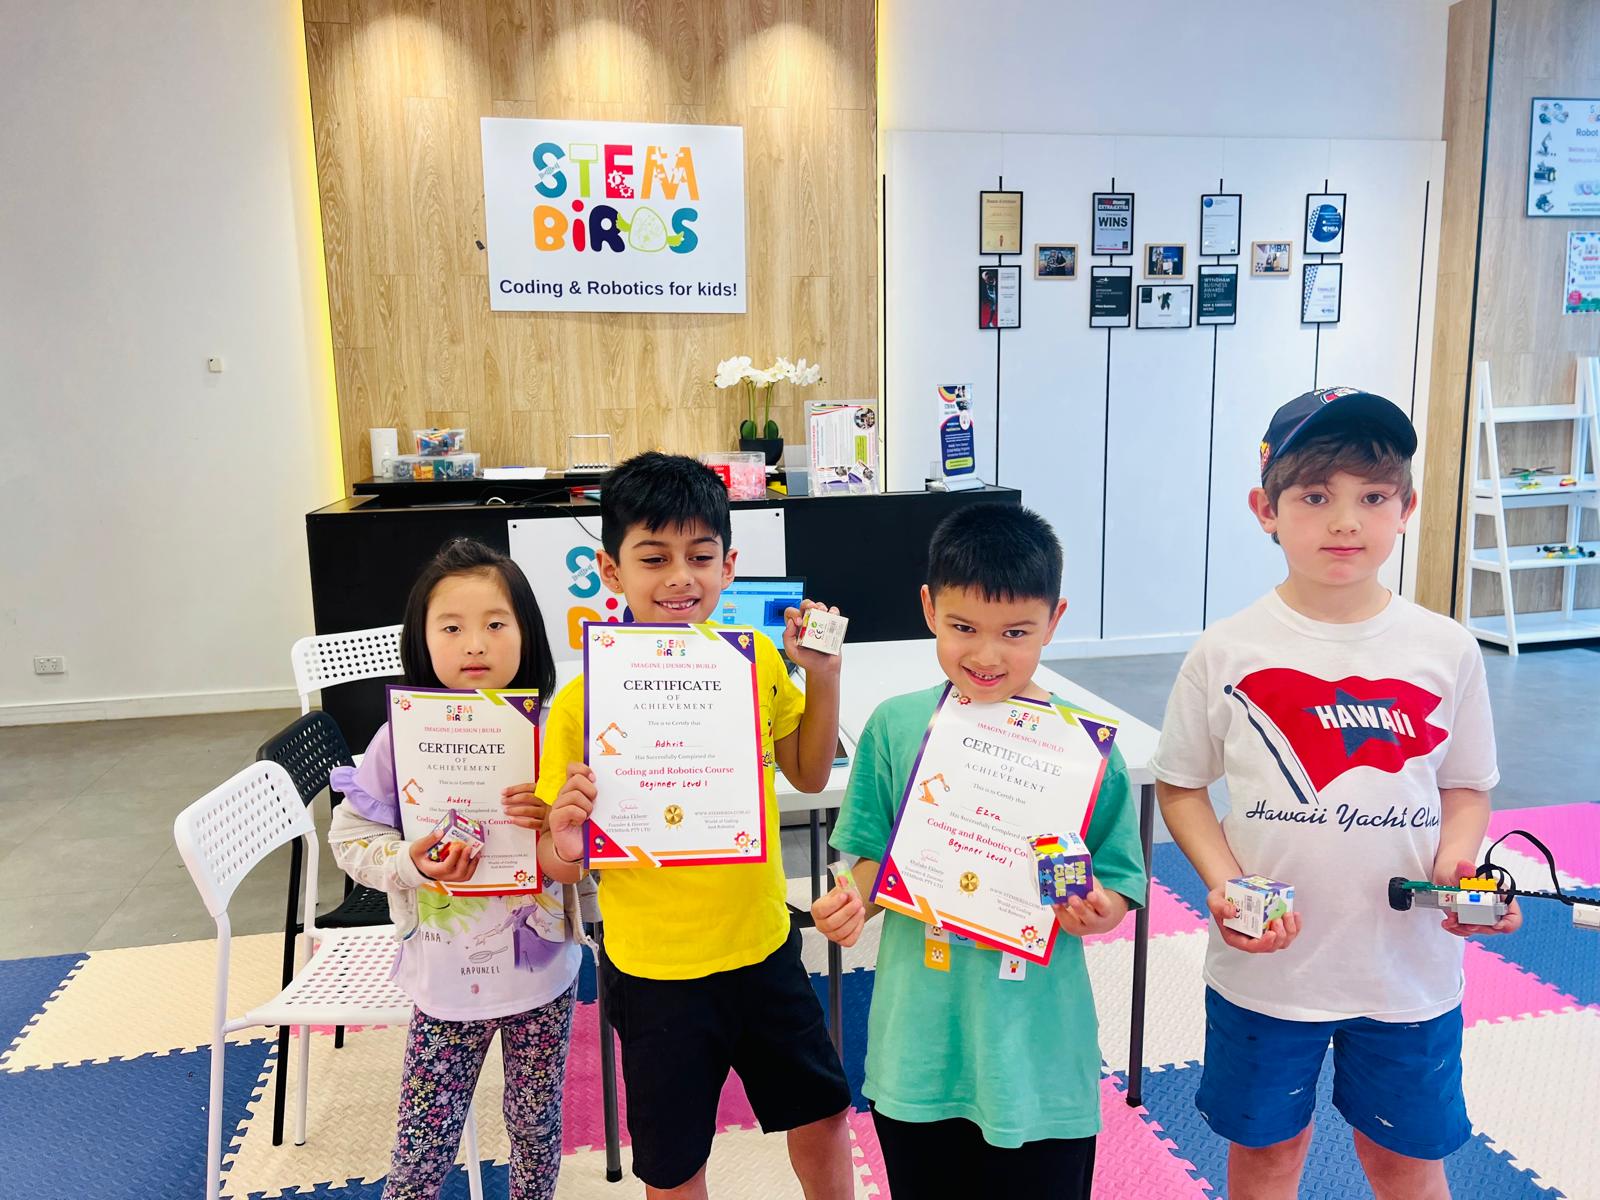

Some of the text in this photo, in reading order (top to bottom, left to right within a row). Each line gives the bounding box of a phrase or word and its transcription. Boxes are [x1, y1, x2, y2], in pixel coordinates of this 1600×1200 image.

[1576, 128, 1598, 136] Robot
[533, 142, 699, 200] STEM
[1098, 217, 1128, 227] WINS
[1269, 244, 1288, 253] MBA
[499, 279, 737, 297] Coding & Robotics for kids!
[623, 680, 722, 691] CERTIFICATE
[977, 721, 1064, 753] IMAGINE DESIGN BUILD
[418, 741, 506, 755] CERTIFICATE
[655, 740, 684, 748] Adhrit
[962, 736, 1063, 777] CERTIFICATE
[427, 764, 497, 772] ACHIEVEMENT
[615, 766, 735, 777] Coding and Robotics Course
[1000, 764, 1015, 773] OF
[964, 762, 1046, 793] ACHIEVEMENT
[639, 780, 677, 791] Beginner
[682, 780, 701, 788] Level
[1245, 799, 1440, 833] Hawaii Yacht Clu
[927, 817, 957, 835] Coding
[957, 829, 975, 840] and
[976, 833, 1012, 853] Robotics
[948, 838, 983, 855] Beginner
[986, 852, 1007, 865] Level
[419, 931, 441, 942] IANA
[460, 965, 501, 976] RAPUNZEL
